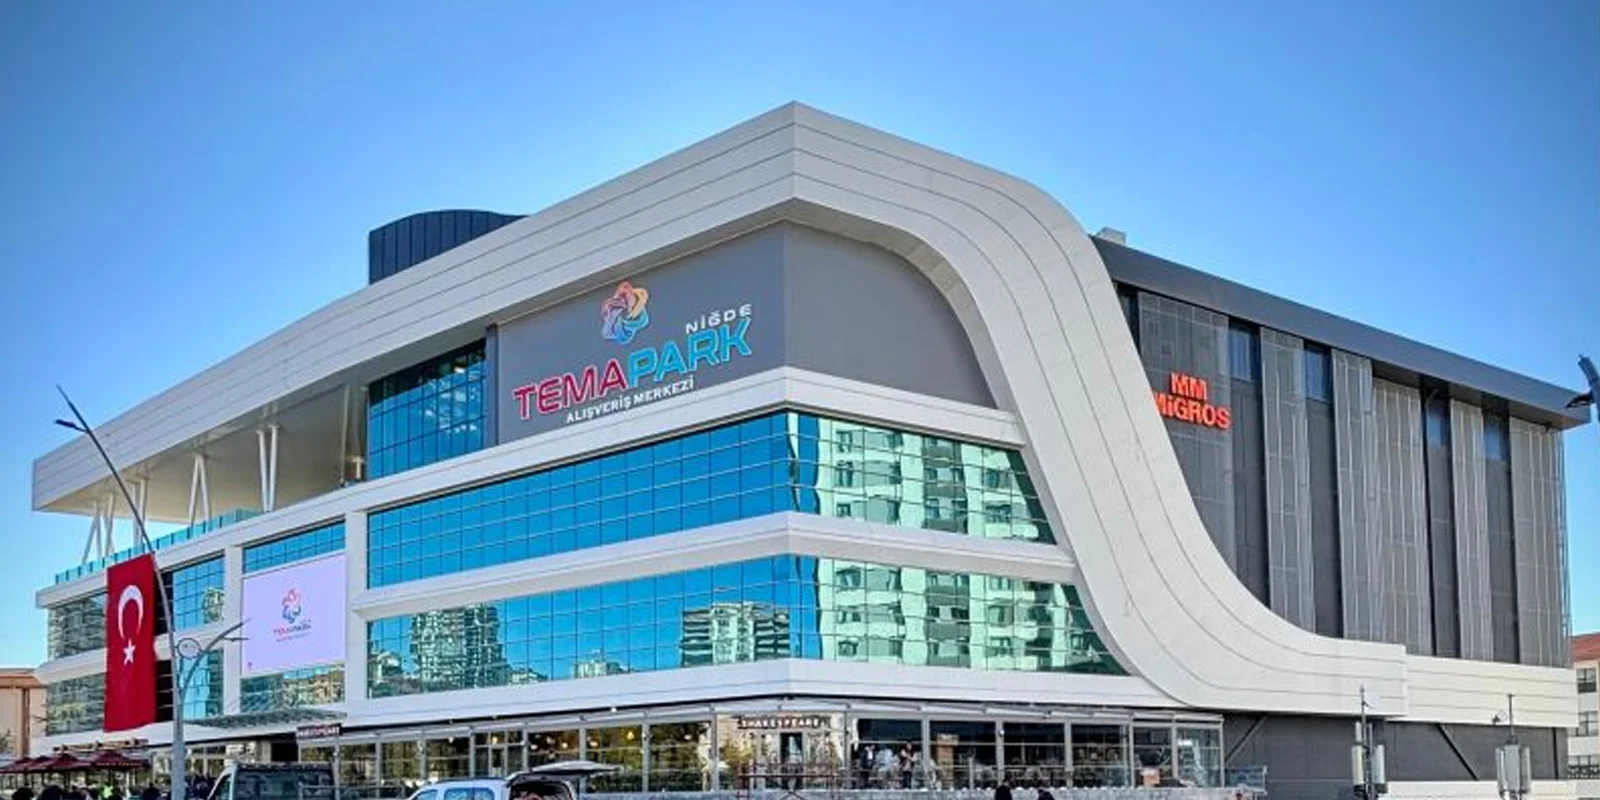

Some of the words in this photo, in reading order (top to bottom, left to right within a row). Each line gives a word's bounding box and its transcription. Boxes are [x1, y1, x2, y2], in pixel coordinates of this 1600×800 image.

[514, 317, 752, 420] TEMAPARK
[1170, 372, 1208, 401] MM
[566, 394, 631, 423] ALIŞVERİŞ
[633, 375, 695, 402] MERKEZİ
